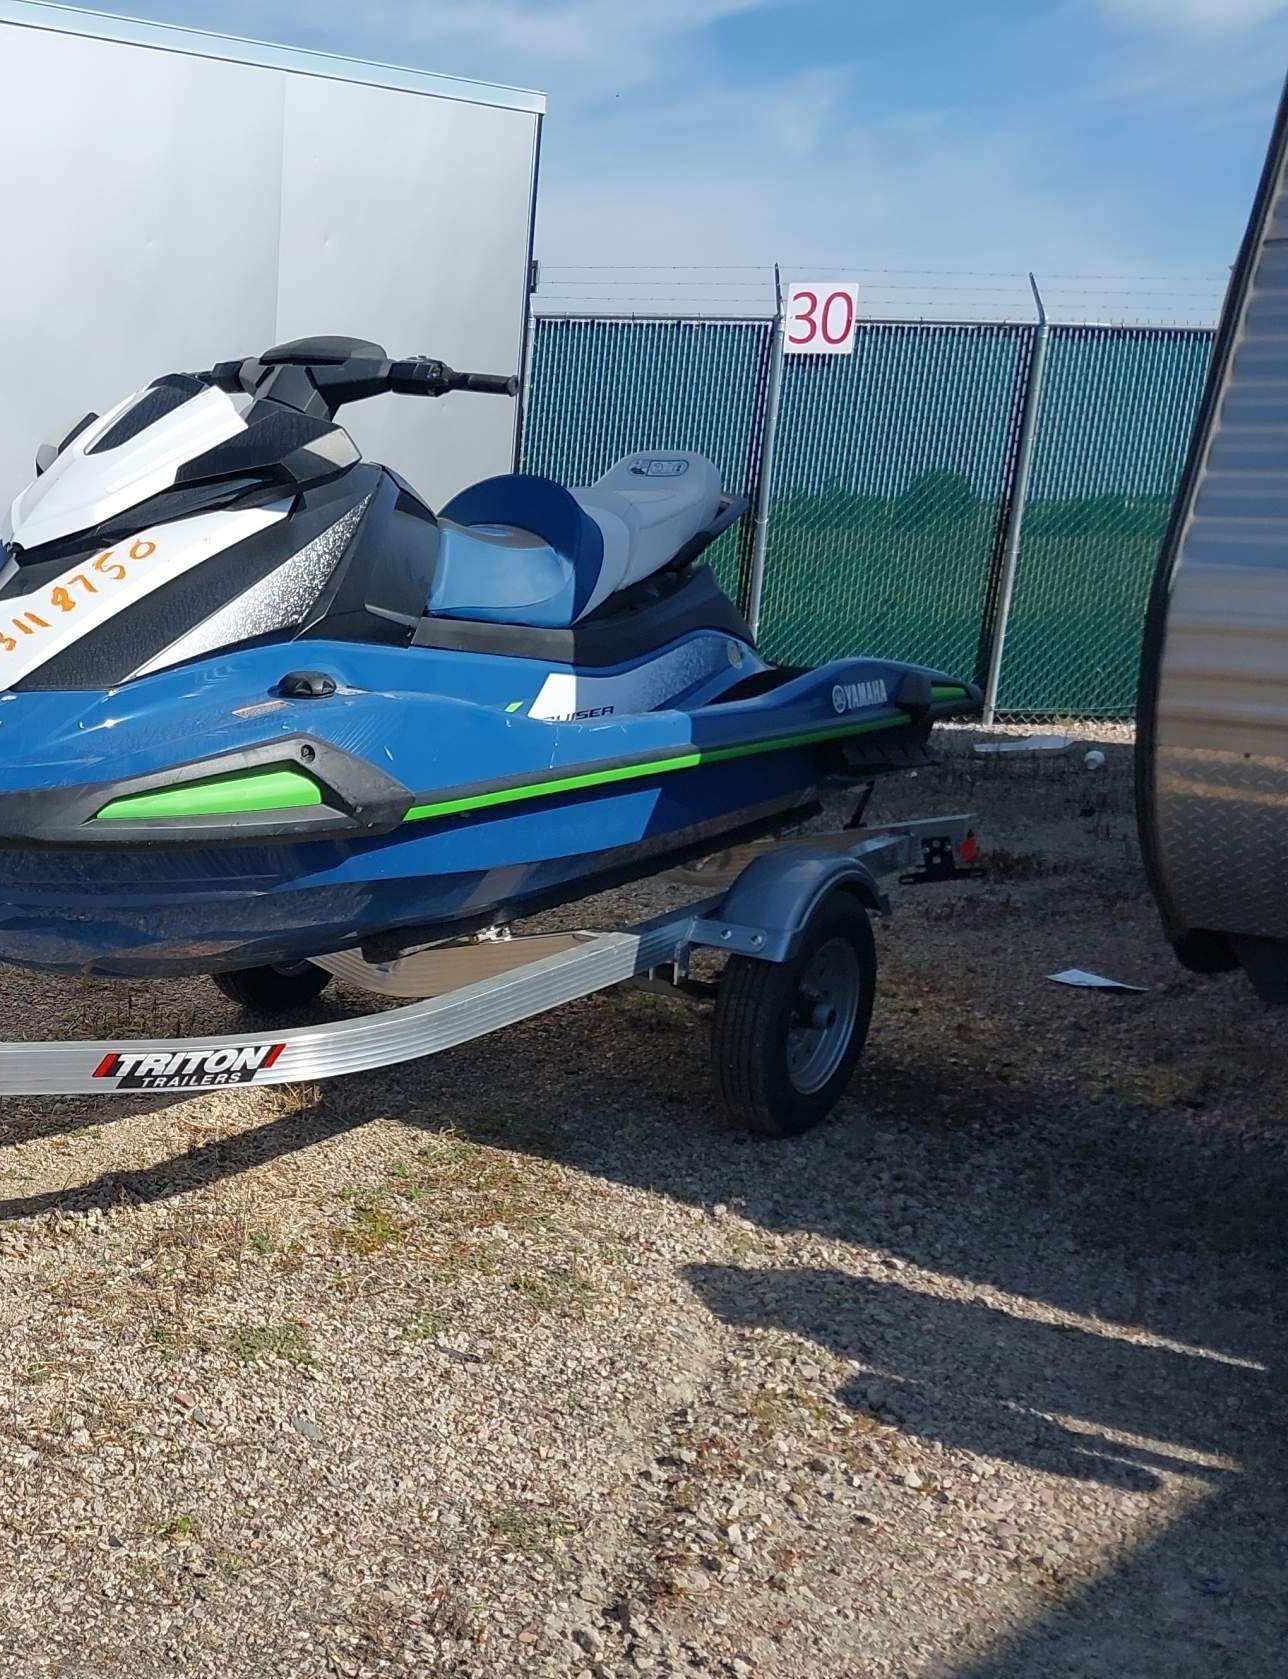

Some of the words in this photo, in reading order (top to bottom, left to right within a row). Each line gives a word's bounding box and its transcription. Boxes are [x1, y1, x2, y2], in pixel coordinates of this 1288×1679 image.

[788, 291, 853, 345] 30
[844, 679, 888, 709] YAMAHA
[115, 1045, 272, 1077] TRITON
[141, 1072, 241, 1088] TRAILERS
